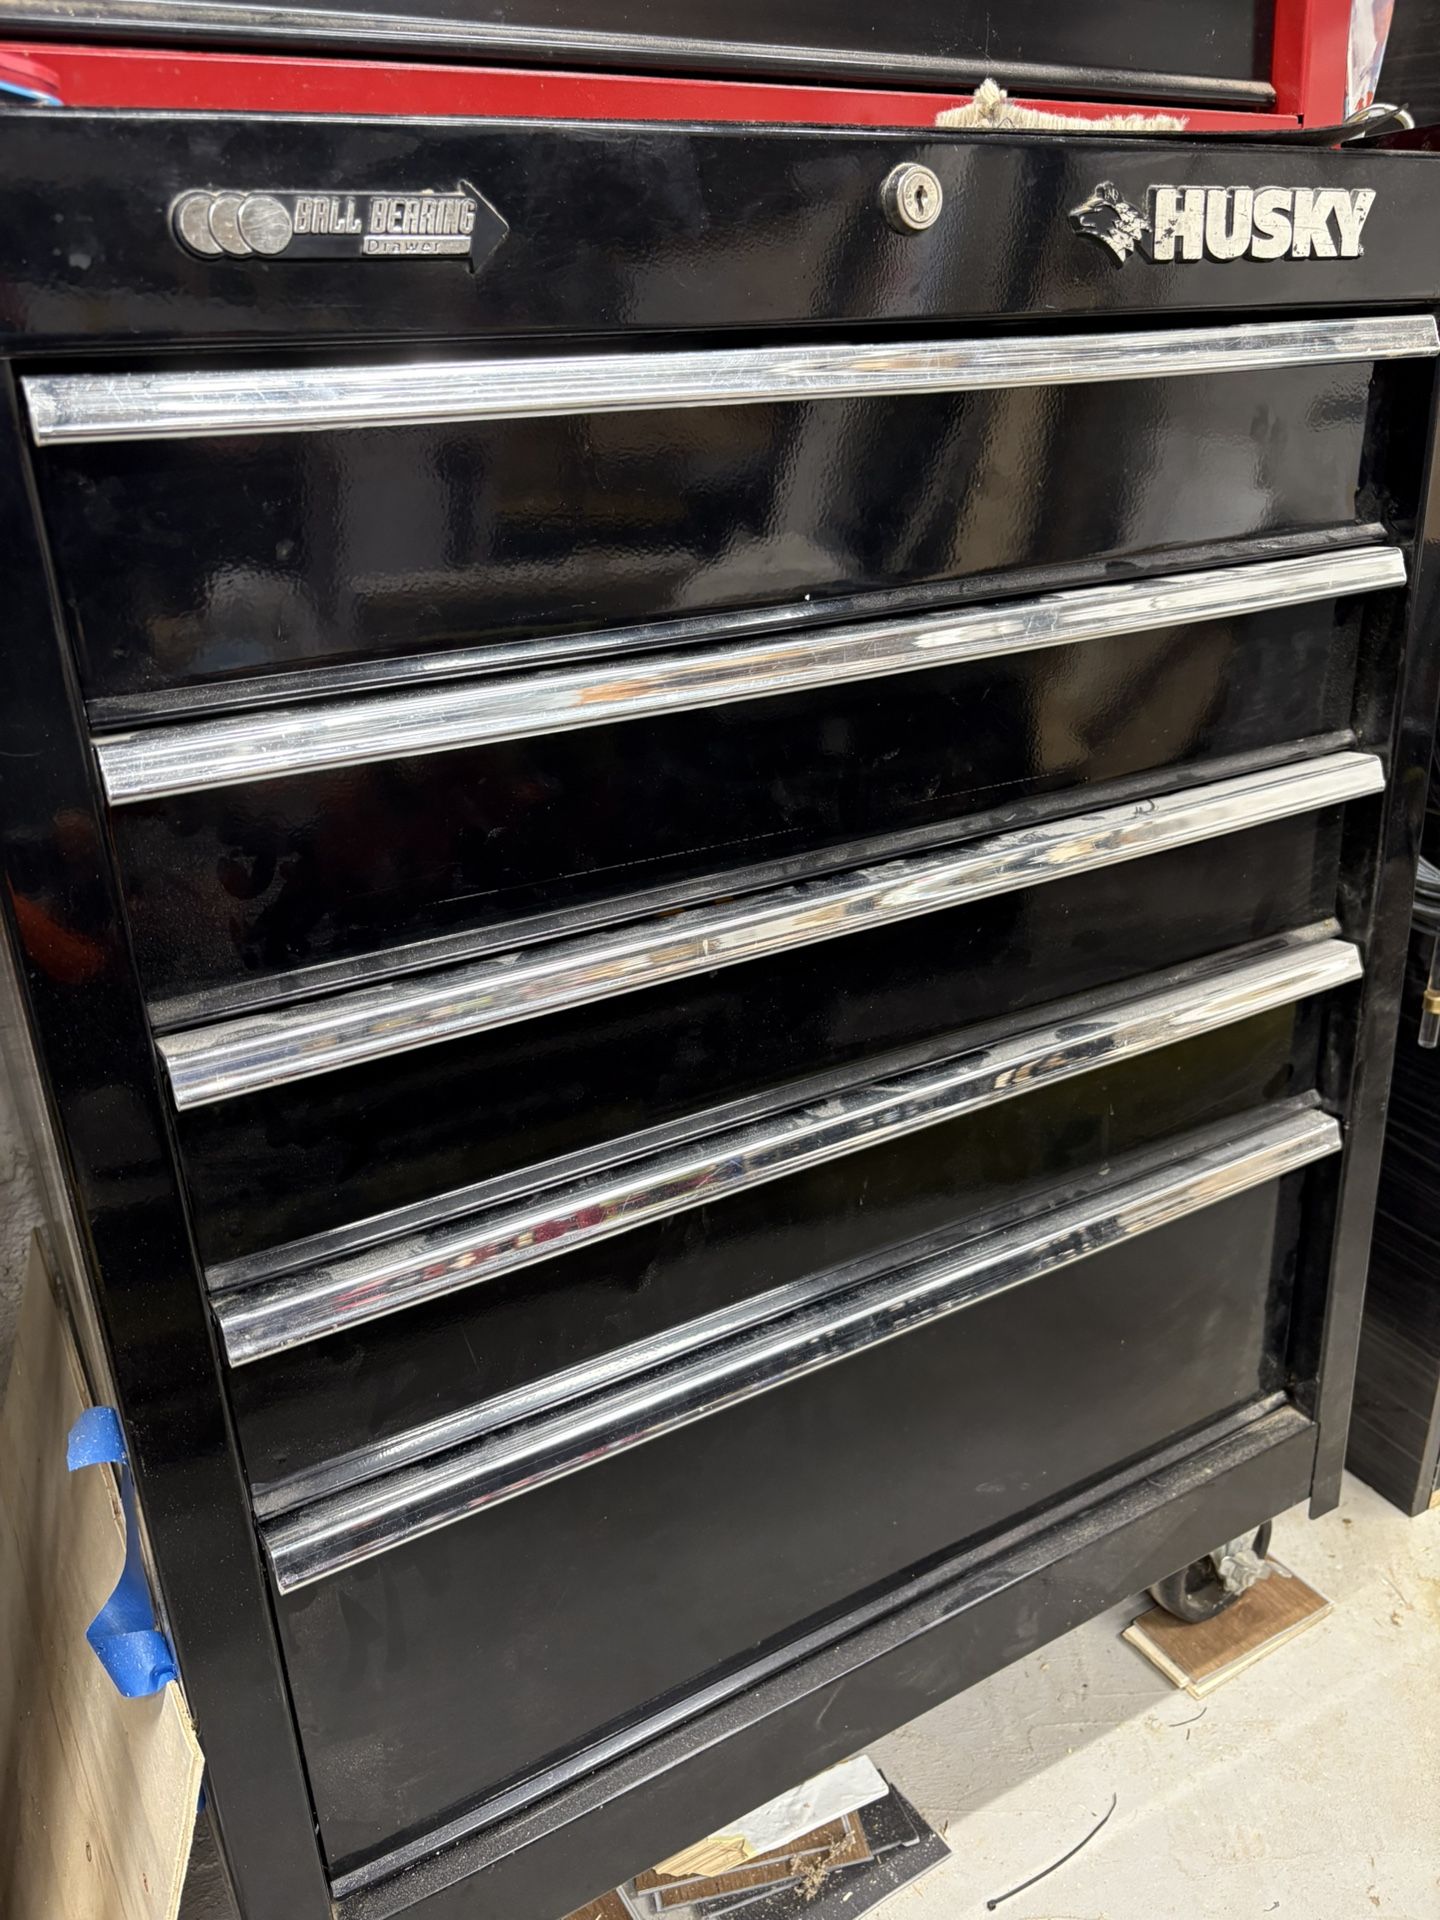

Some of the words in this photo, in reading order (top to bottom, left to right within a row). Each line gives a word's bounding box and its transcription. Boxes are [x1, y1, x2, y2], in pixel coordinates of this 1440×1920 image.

[293, 196, 362, 234] BALL
[371, 196, 477, 234] BEARING
[1151, 186, 1376, 261] HUSKY
[367, 239, 441, 252] Drawer
